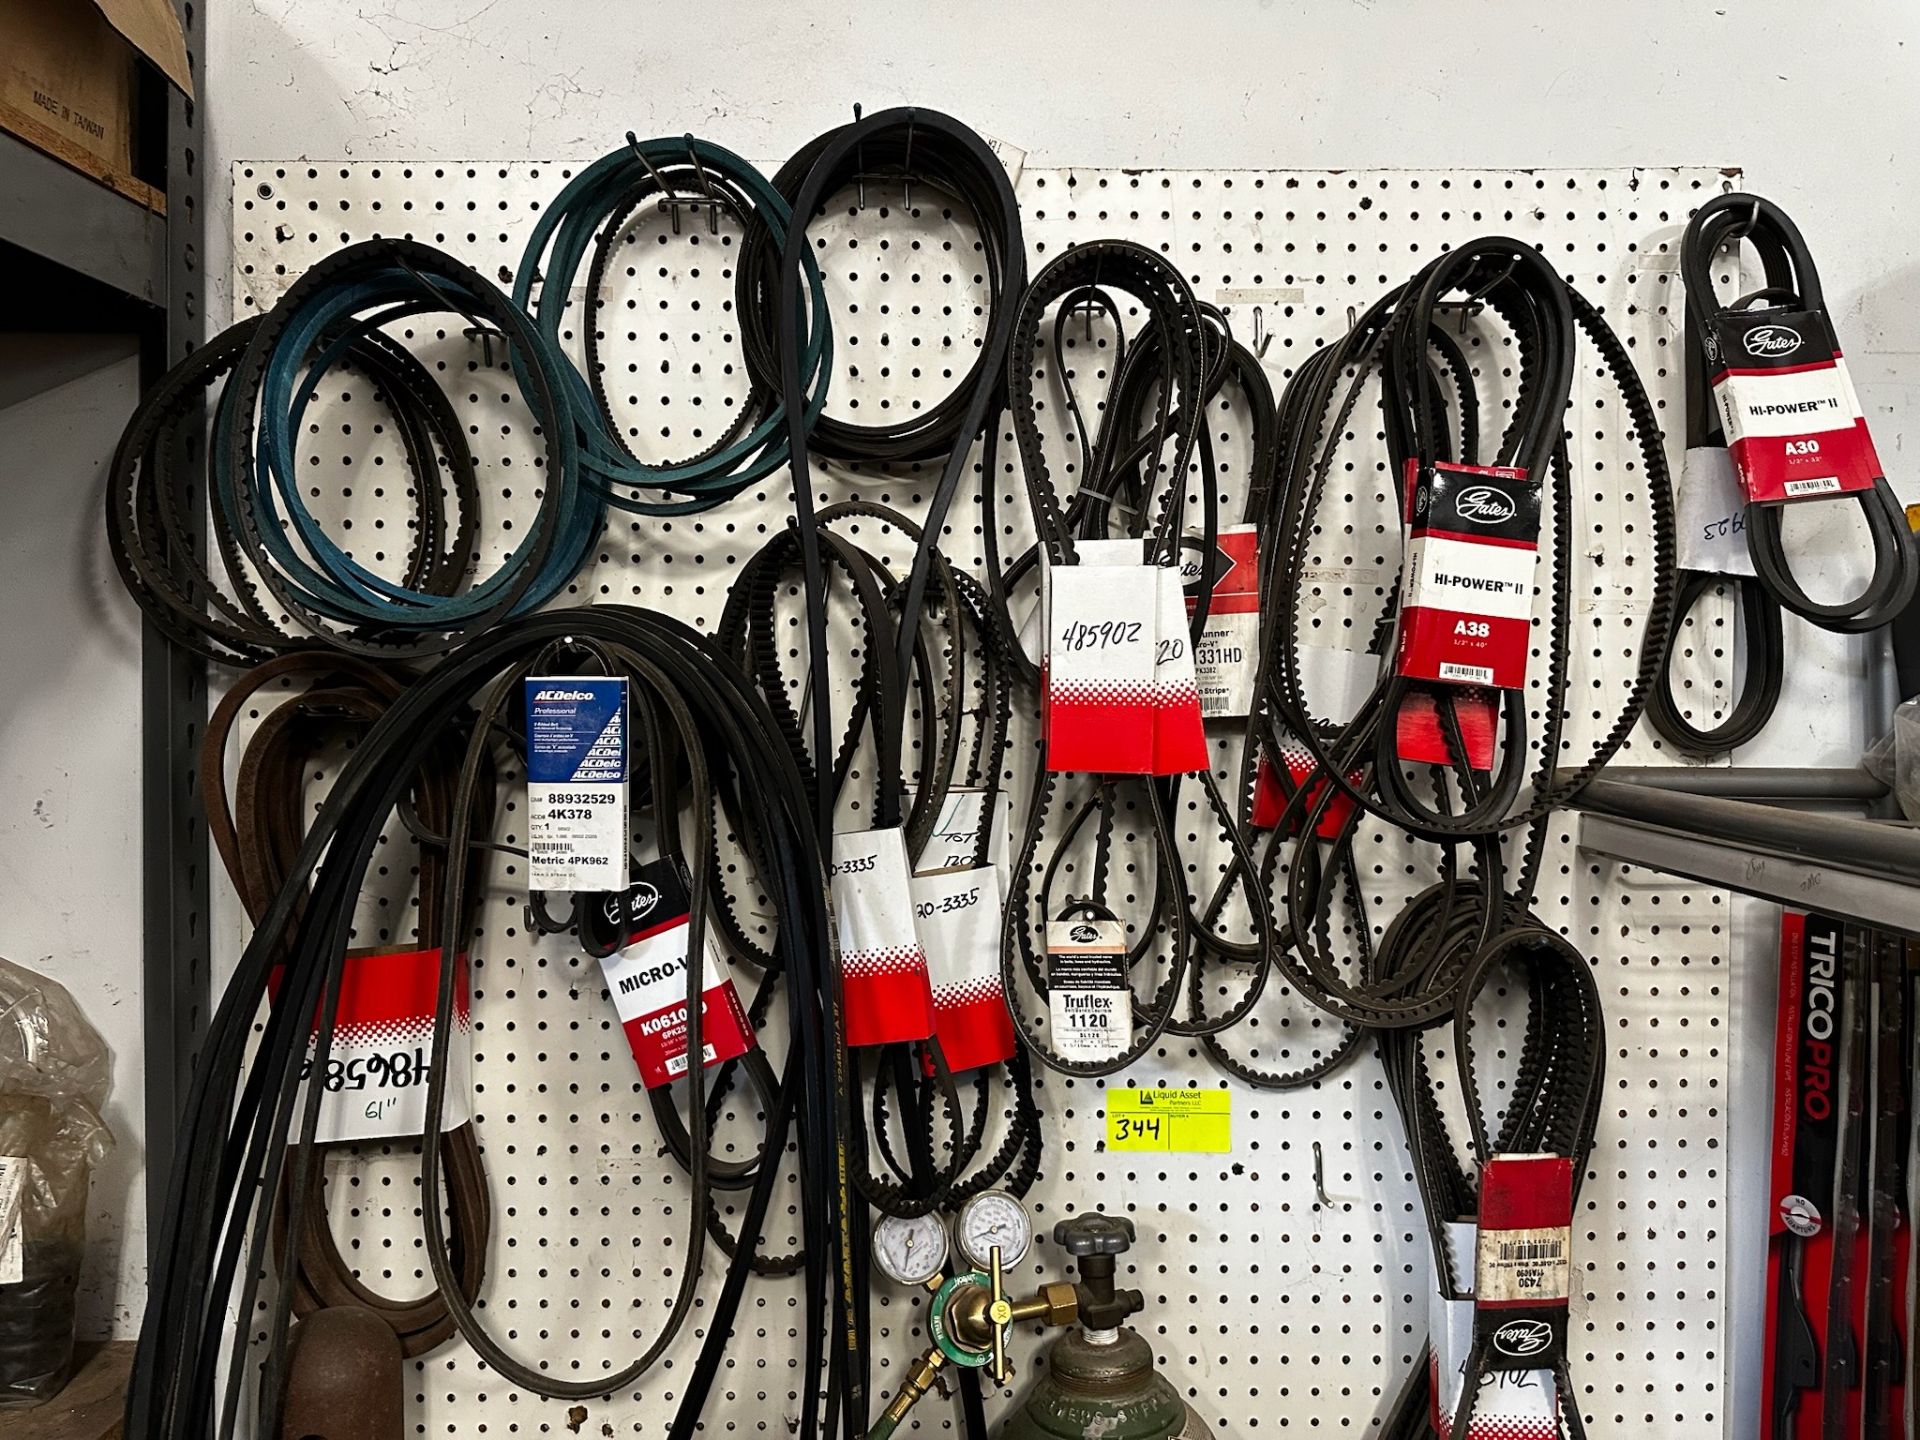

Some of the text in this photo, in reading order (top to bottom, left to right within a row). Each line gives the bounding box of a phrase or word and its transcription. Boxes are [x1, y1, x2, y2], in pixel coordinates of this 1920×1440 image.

[33, 90, 105, 140] MADE IN TAIWAN
[1746, 327, 1801, 356] Gates
[1785, 439, 1820, 456] A30
[1458, 488, 1514, 521] Gates
[1453, 619, 1490, 637] A38
[1062, 620, 1142, 652] 485902
[535, 690, 595, 701] ACDelco
[534, 707, 577, 715] Professional
[571, 770, 622, 779] ACDelco
[548, 793, 616, 805] 88932529
[547, 808, 593, 820] 4K378
[544, 822, 550, 831] 1
[531, 855, 609, 866] Metric 4PK962
[830, 854, 878, 877] 0-3335
[1069, 1014, 1108, 1028] 1120
[1153, 1090, 1201, 1099] Liquid Asset
[1116, 1118, 1160, 1140] 344
[1518, 1277, 1542, 1288] 7430
